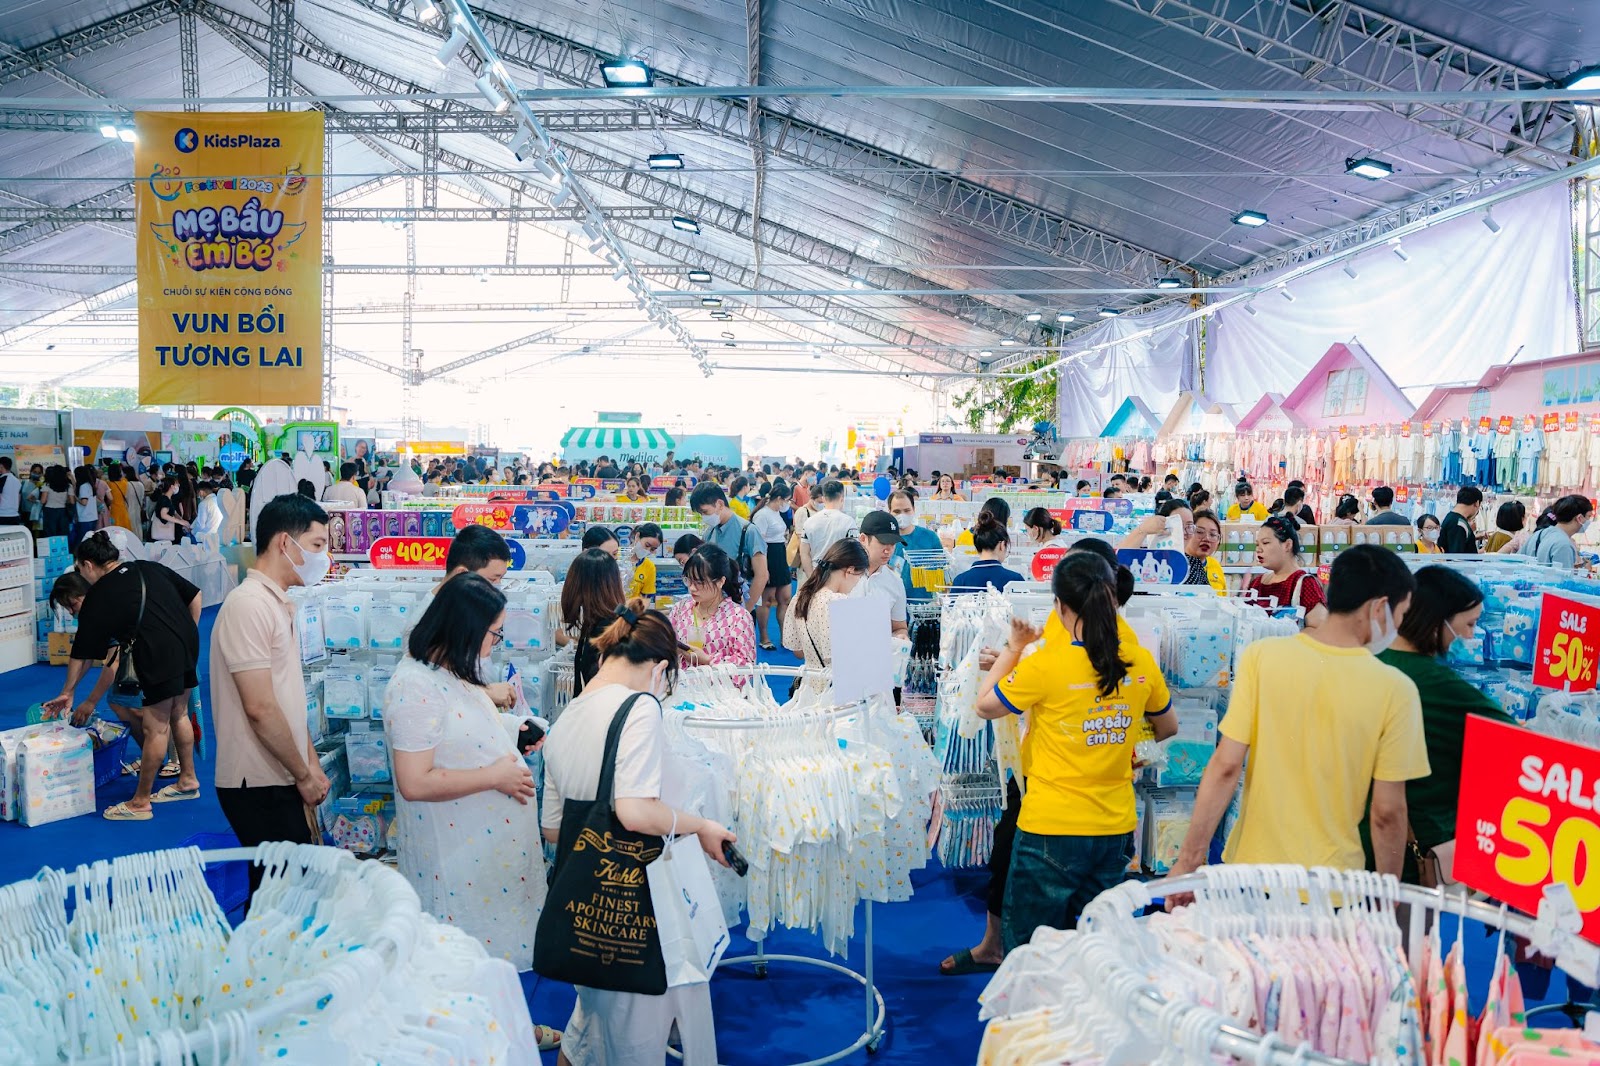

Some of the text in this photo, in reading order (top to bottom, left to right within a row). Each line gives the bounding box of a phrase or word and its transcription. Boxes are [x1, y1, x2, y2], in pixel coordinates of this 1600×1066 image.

[204, 134, 280, 149] KidsPlaza
[185, 178, 273, 193] Festival 2023
[163, 286, 293, 298] CHUỖI SỰ KIỆN CỘNG ĐỒNG
[172, 304, 285, 333] VUN BỒI
[155, 346, 303, 367] TƯƠNG LAI
[380, 546, 393, 554] QUÀ
[1559, 610, 1588, 634] SALE
[1543, 648, 1551, 656] UP
[1549, 632, 1593, 682] 50%
[1477, 818, 1497, 836] UP
[1476, 835, 1494, 854] TO
[591, 892, 640, 913] FINEST
[565, 900, 657, 929] APOTHECARY
[573, 916, 647, 941] SKINCARE
